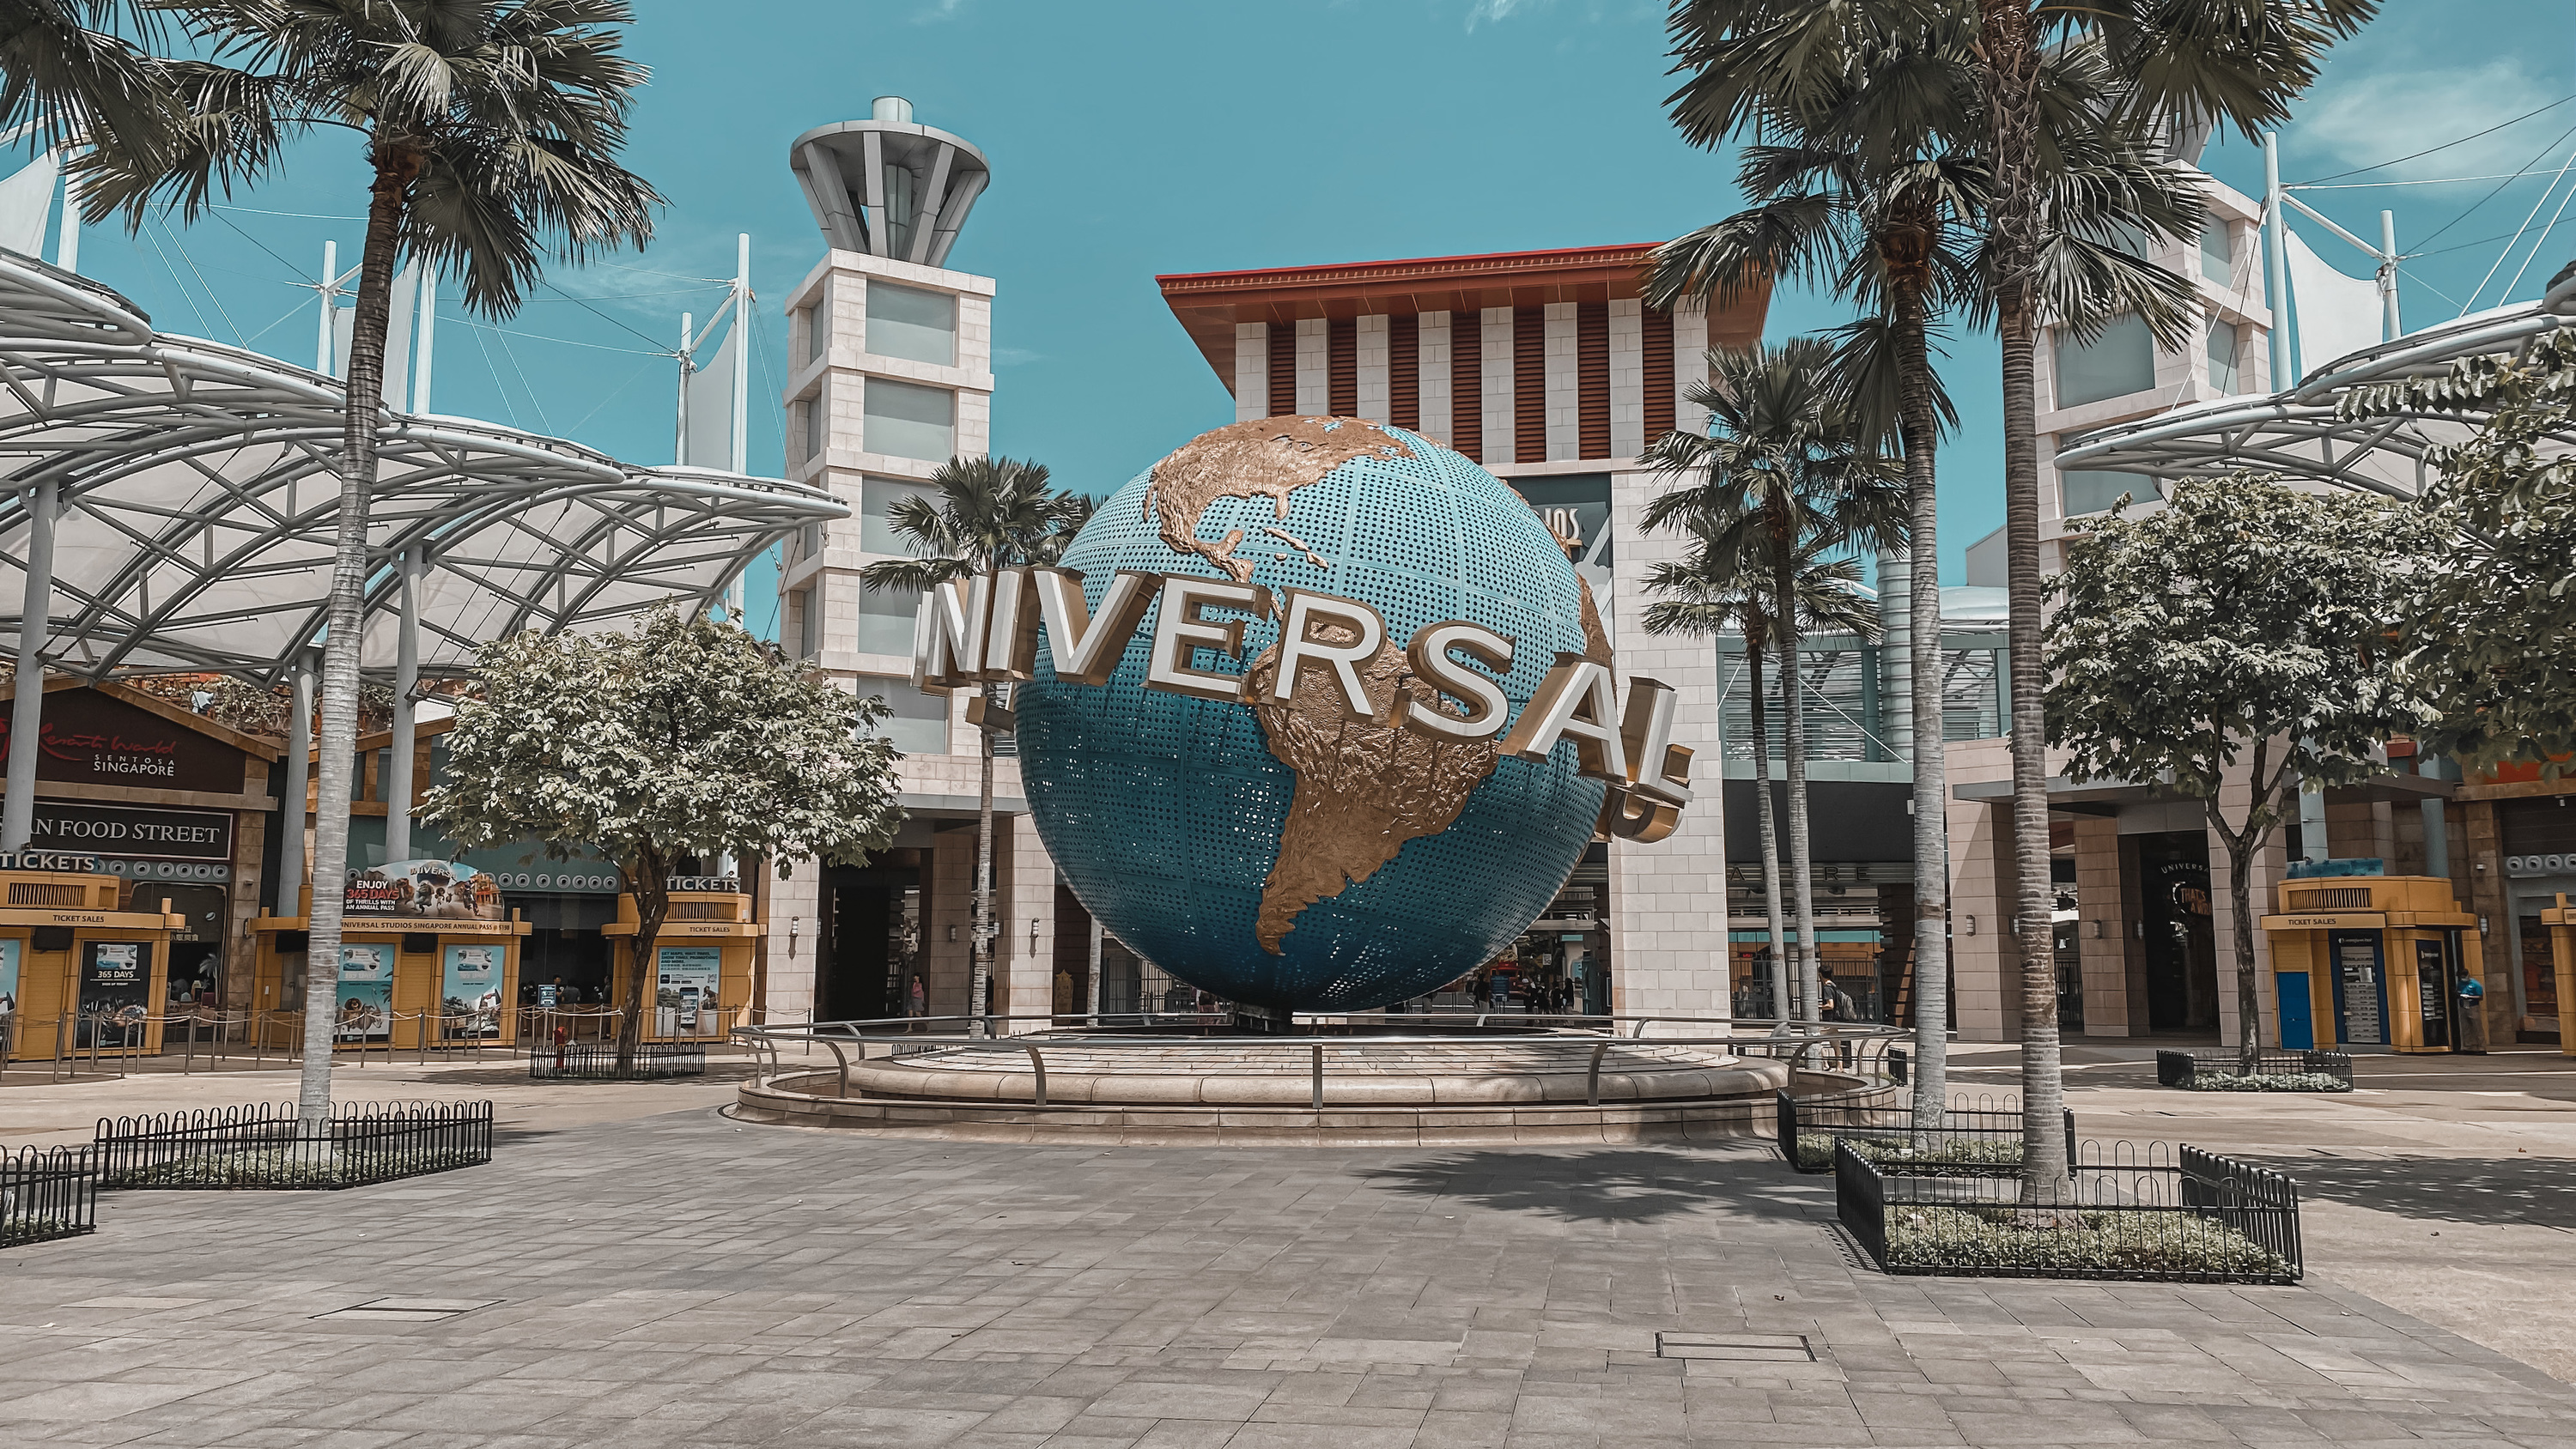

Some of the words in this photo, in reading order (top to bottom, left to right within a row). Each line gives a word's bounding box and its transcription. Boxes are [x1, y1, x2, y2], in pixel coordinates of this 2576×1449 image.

[111, 736, 177, 755] World
[94, 754, 175, 766] SENTOSA
[93, 761, 175, 776] SINGAPORE
[58, 820, 127, 839] FOOD
[132, 823, 220, 843] STREET
[0, 852, 95, 871] TICKETS
[356, 881, 388, 889] ENJOY
[666, 877, 740, 891] TICKETS
[347, 889, 368, 899] 365
[369, 889, 400, 900] DAYS
